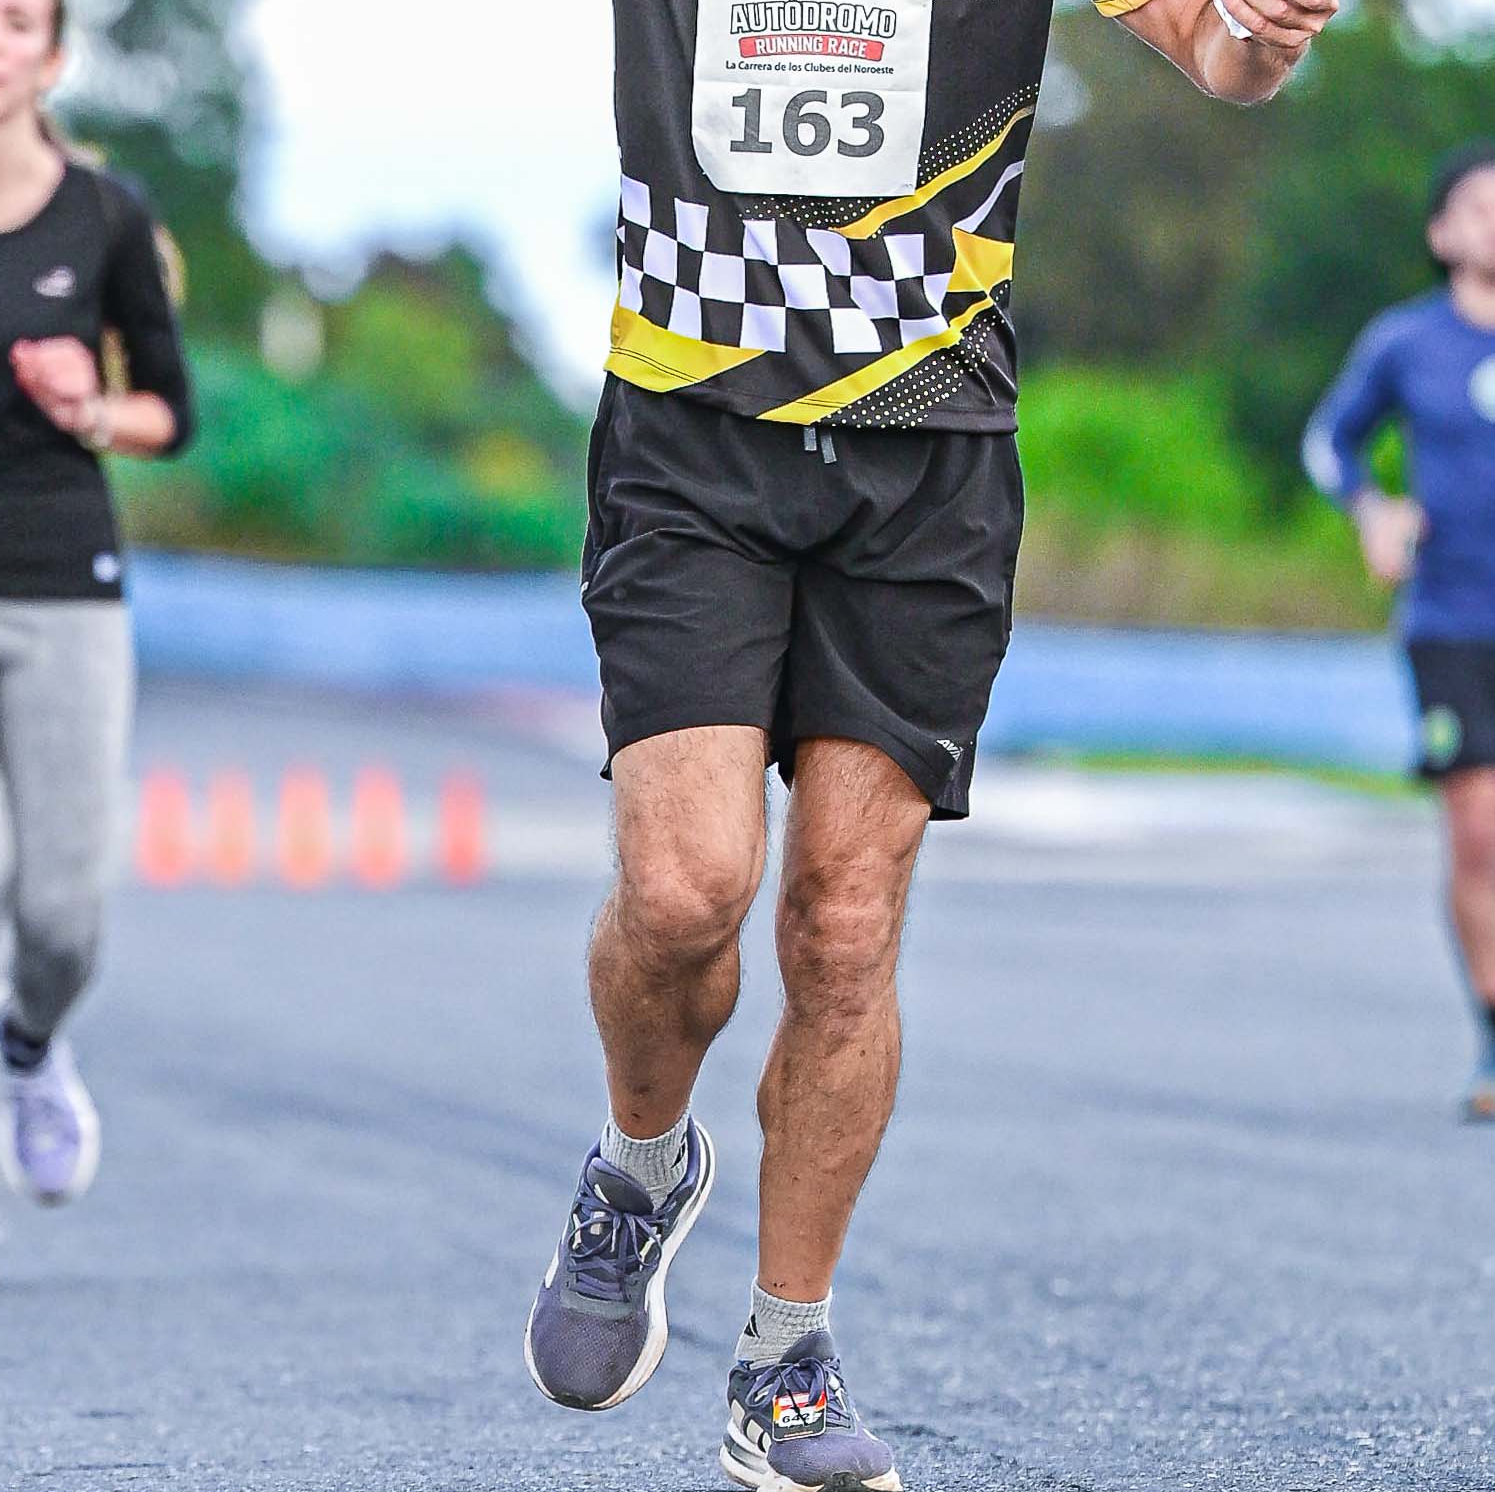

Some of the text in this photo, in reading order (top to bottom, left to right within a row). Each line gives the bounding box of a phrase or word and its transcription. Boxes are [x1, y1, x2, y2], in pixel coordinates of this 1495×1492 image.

[755, 36, 868, 58] RUNNING RACE
[725, 60, 894, 74] La Carrera de los Clubes del Noroeste
[730, 88, 885, 158] 163
